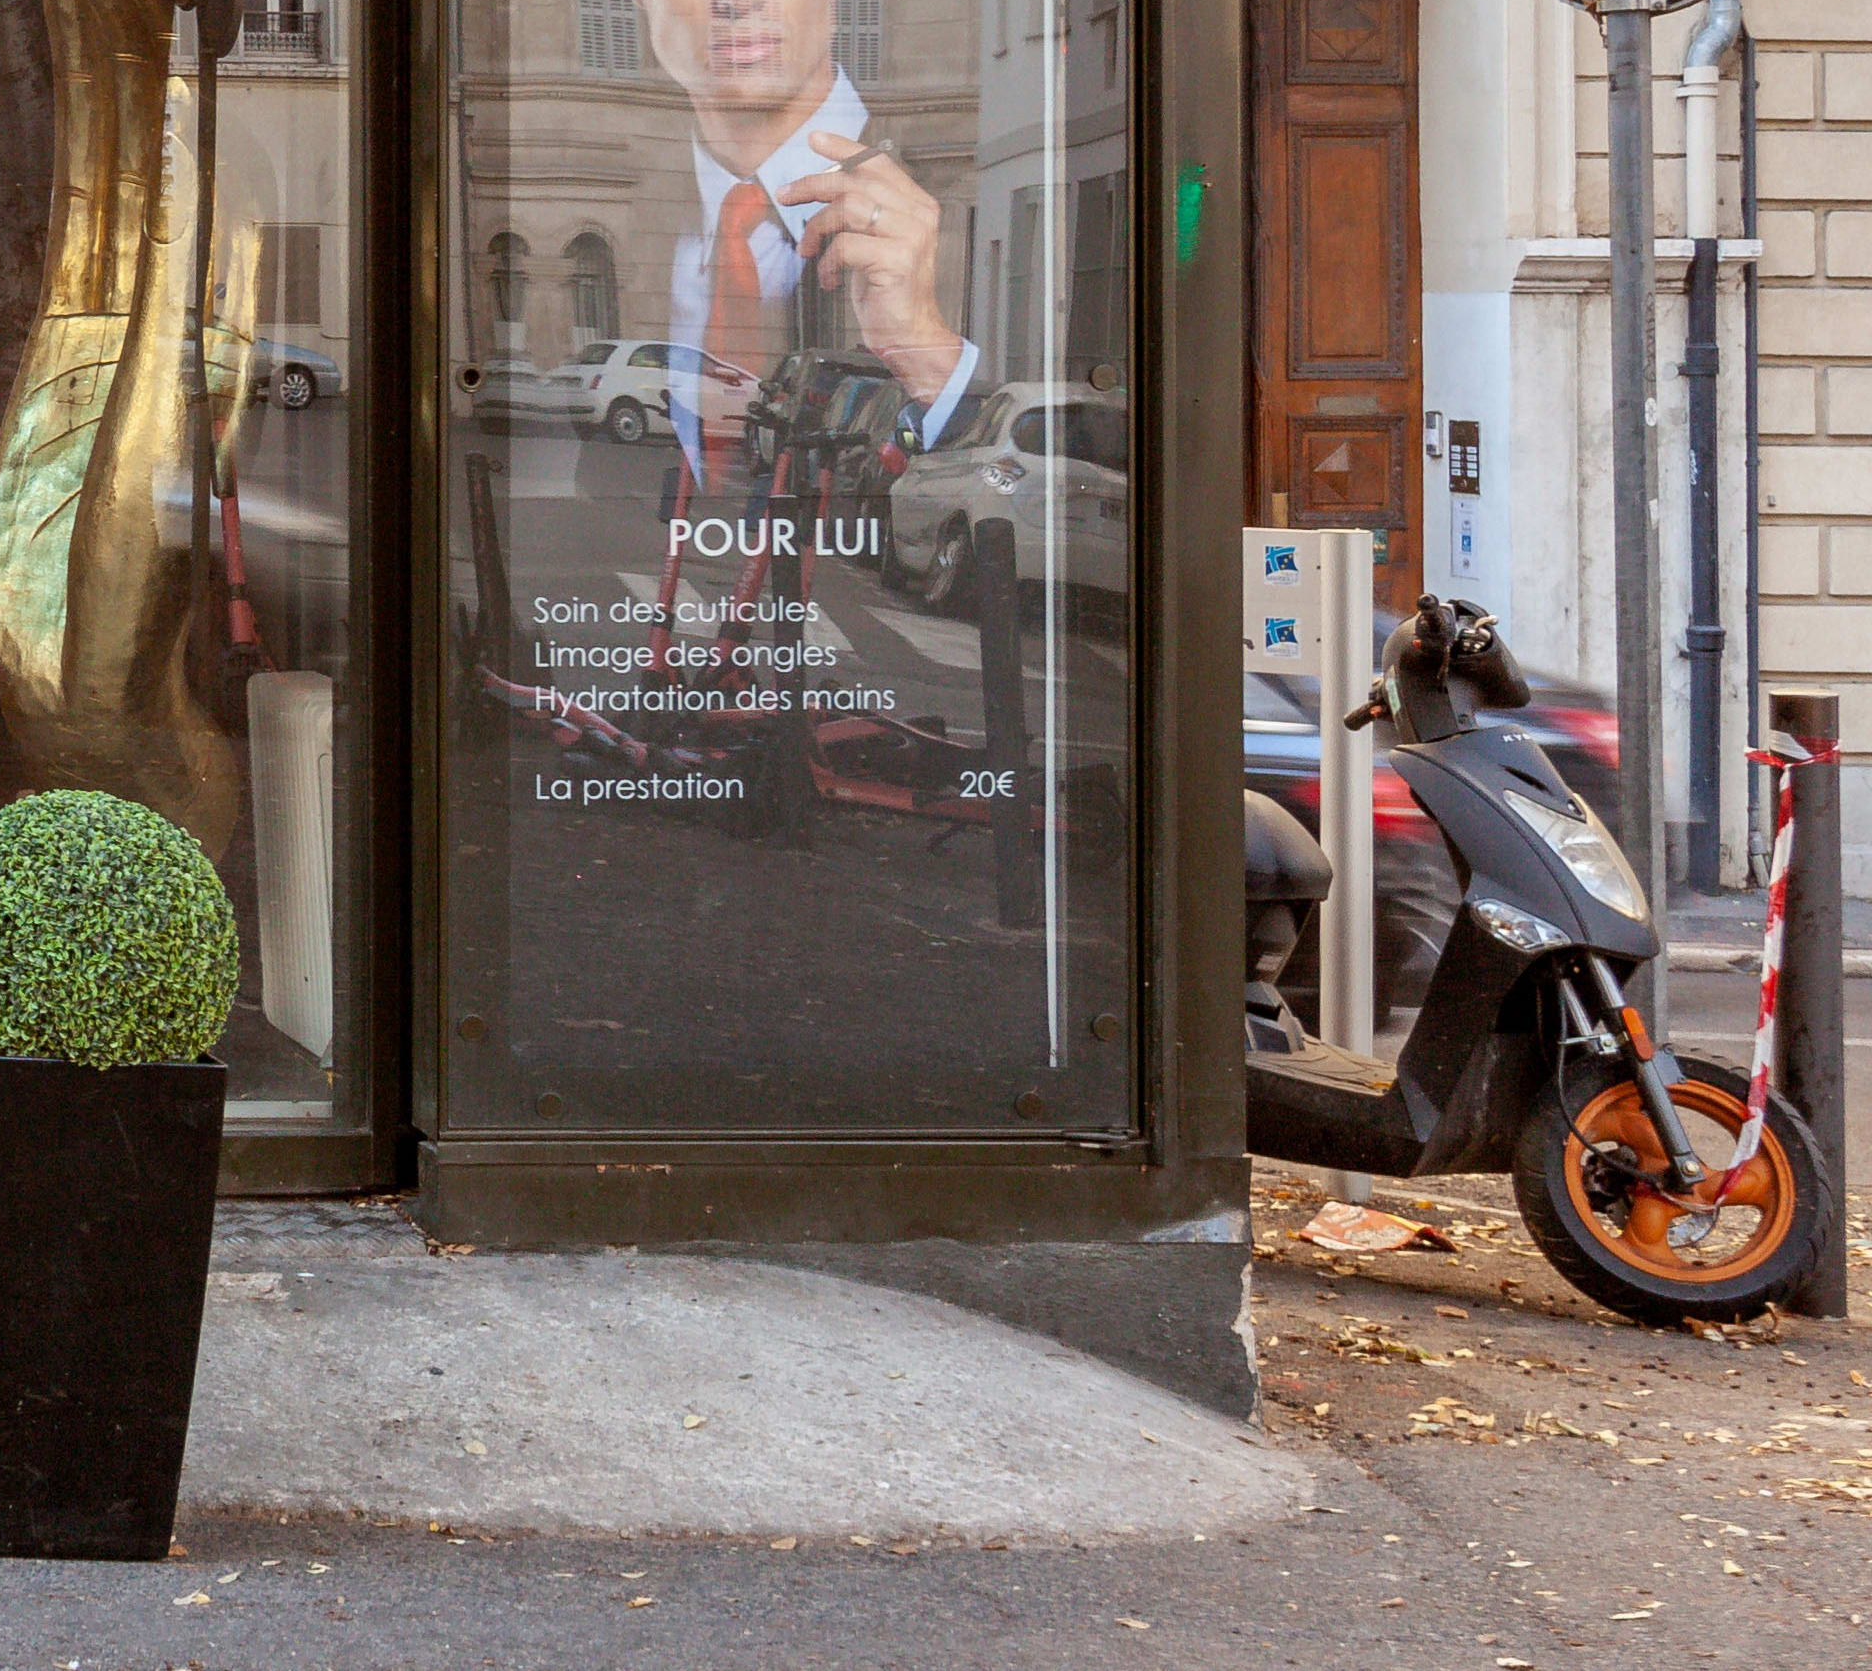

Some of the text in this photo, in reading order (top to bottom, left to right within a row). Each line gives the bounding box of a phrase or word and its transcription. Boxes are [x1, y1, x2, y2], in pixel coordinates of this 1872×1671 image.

[669, 517, 878, 557] POUR LUI
[533, 595, 819, 624] Soin des cuticules
[535, 640, 837, 674] Limage des ongles
[534, 682, 895, 717] Hydratation des mains
[536, 770, 1015, 806] La prestation 20€
